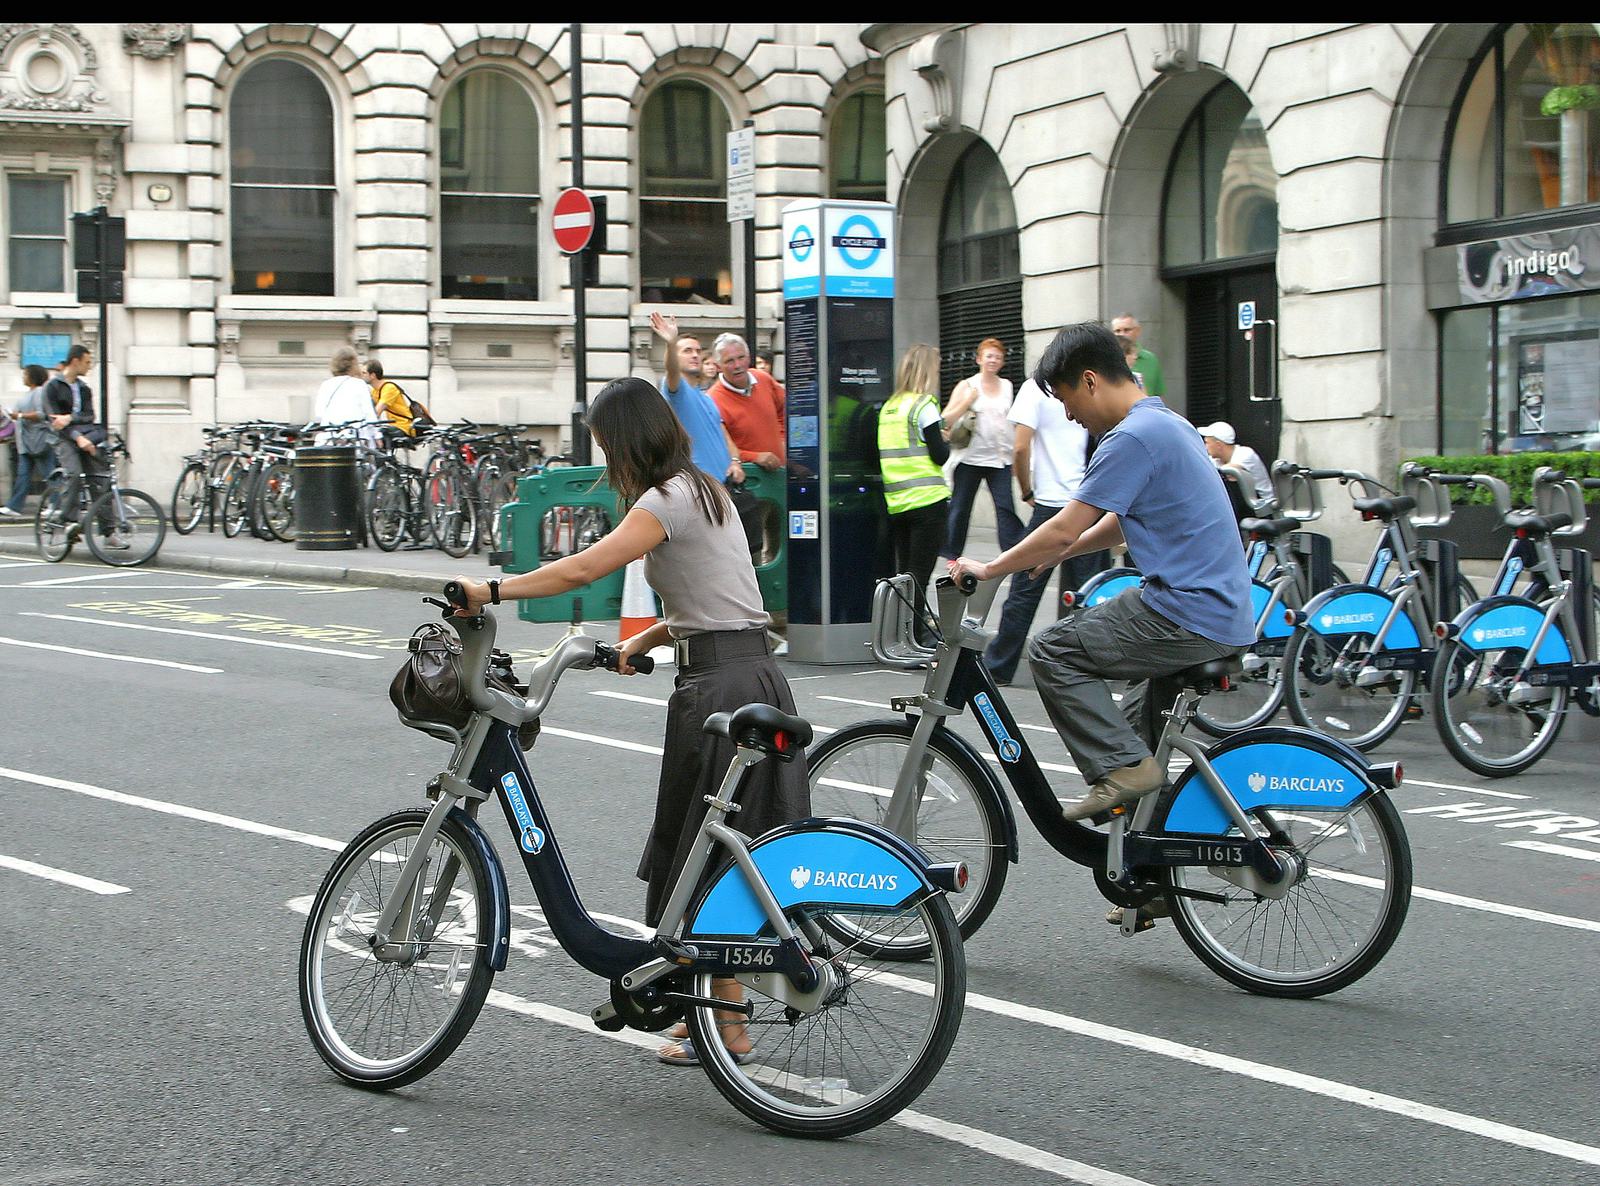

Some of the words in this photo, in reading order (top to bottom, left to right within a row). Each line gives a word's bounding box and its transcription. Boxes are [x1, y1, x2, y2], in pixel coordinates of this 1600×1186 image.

[840, 239, 862, 247] CYCLE
[1507, 250, 1569, 276] indigo
[1333, 612, 1375, 625] BARCLAYS
[982, 705, 1005, 738] BARCLAYS
[1269, 776, 1345, 793] BARCLAYS
[509, 787, 530, 825] BARCLAYS
[1197, 846, 1243, 863] 11613
[813, 870, 898, 891] BARCLAYS
[723, 946, 774, 966] 15546
